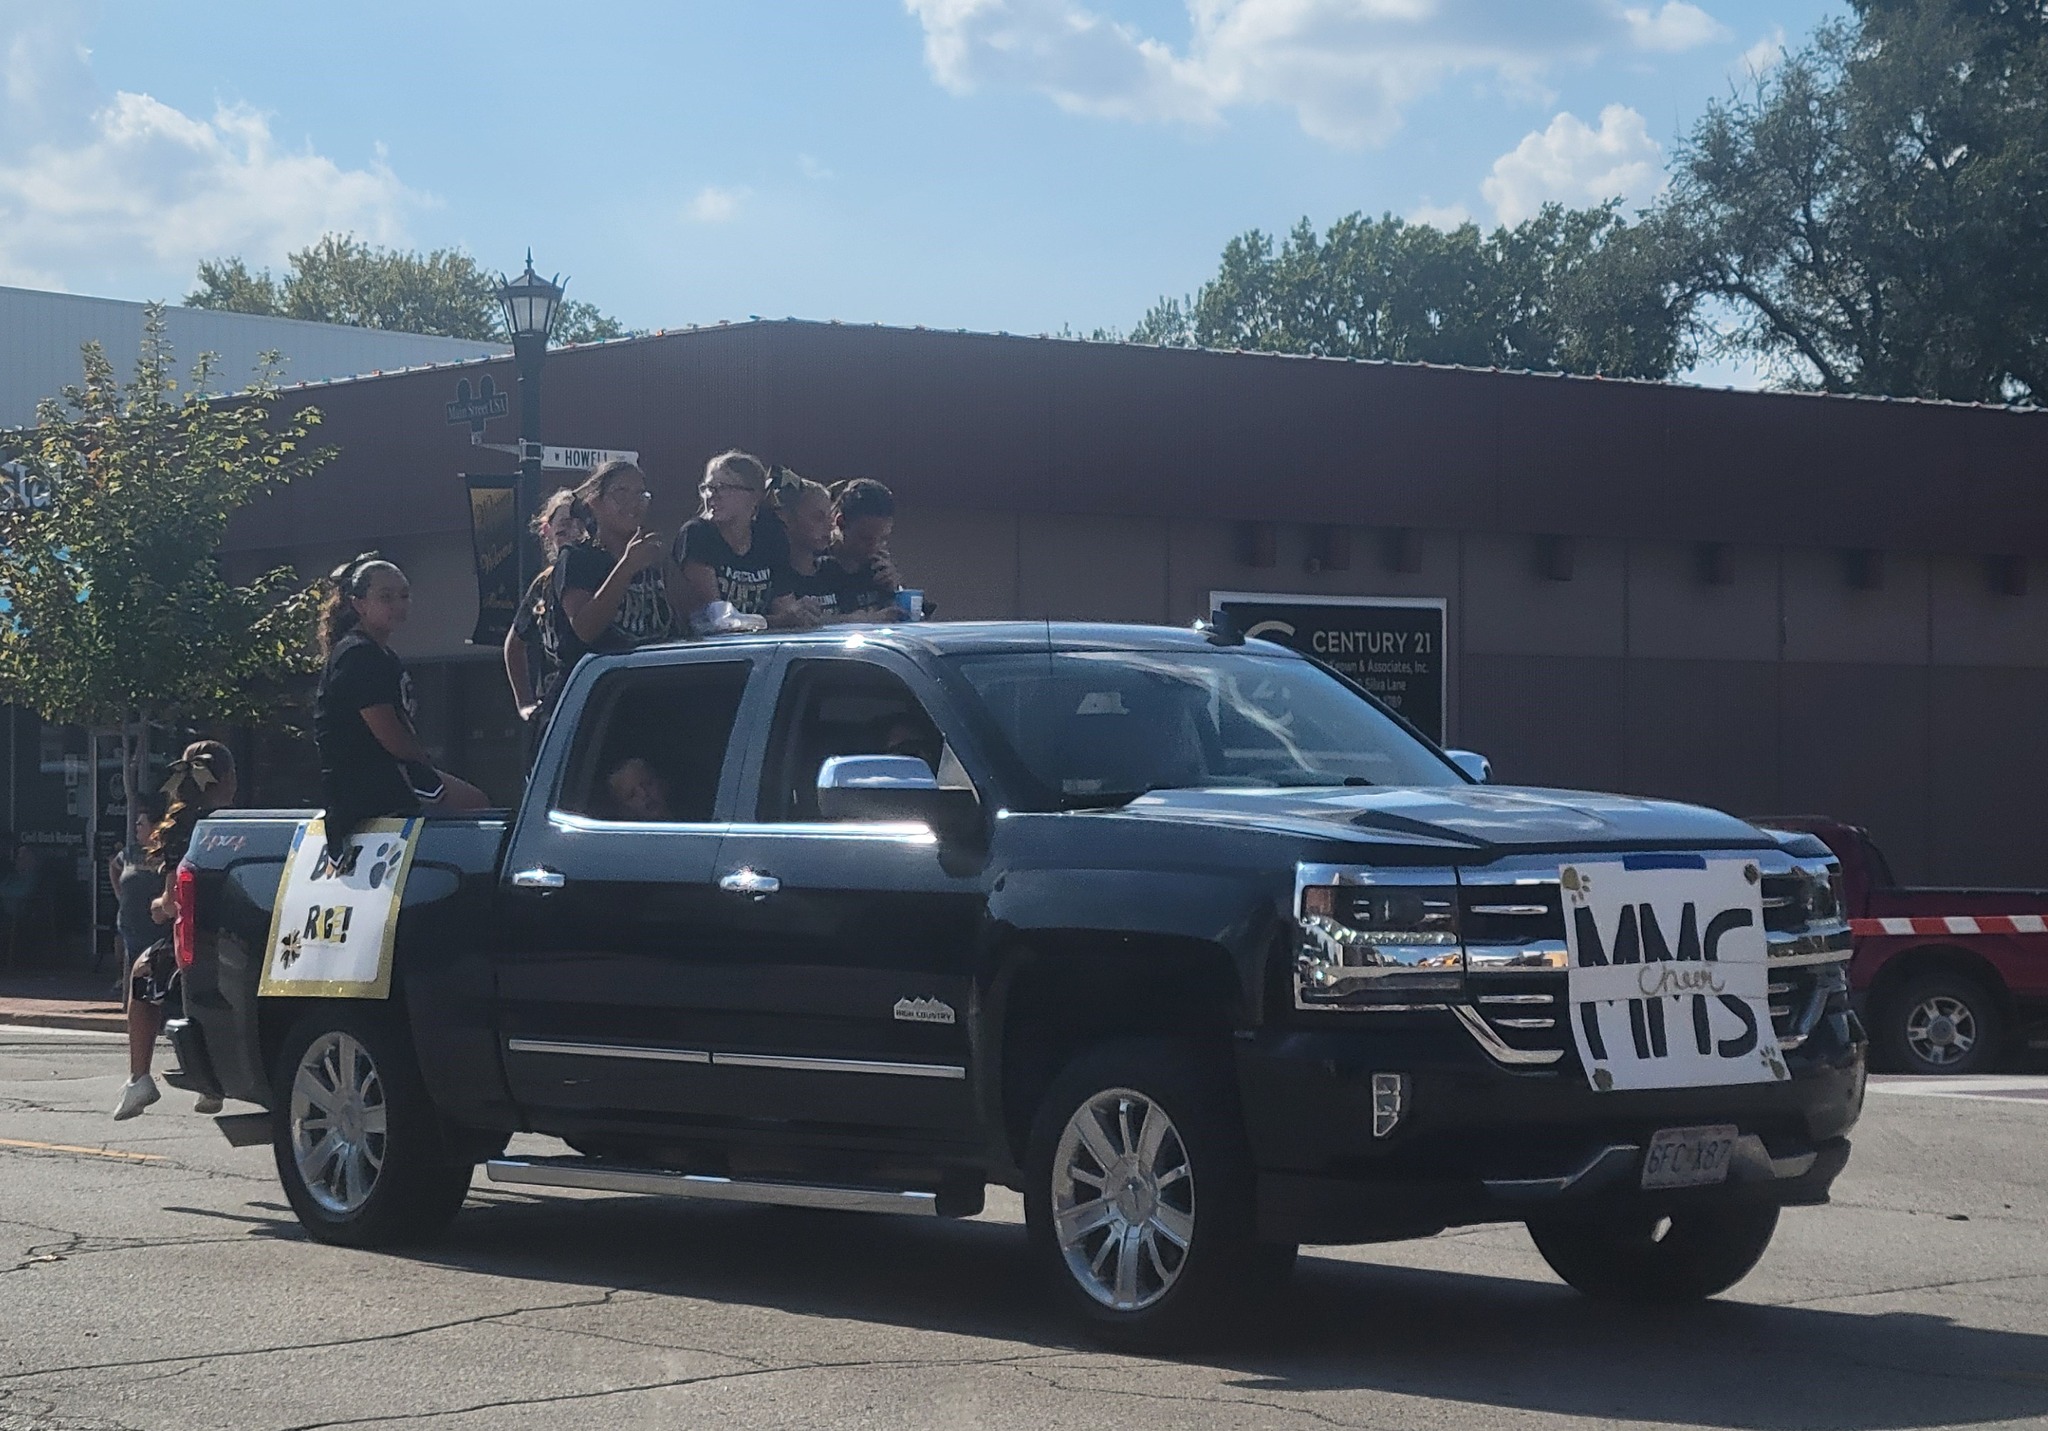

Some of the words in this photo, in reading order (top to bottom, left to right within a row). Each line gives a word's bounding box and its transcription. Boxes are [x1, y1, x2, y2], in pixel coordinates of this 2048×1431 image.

[467, 402, 489, 416] Street
[1312, 632, 1407, 653] CENTURY
[1414, 633, 1431, 654] 21
[1358, 659, 1365, 672] &
[1367, 659, 1413, 675] Associates,
[1414, 660, 1429, 674] Inc.
[1386, 678, 1406, 691] Lane
[1574, 901, 1758, 1060] MMS
[1638, 958, 1726, 996] Cheer
